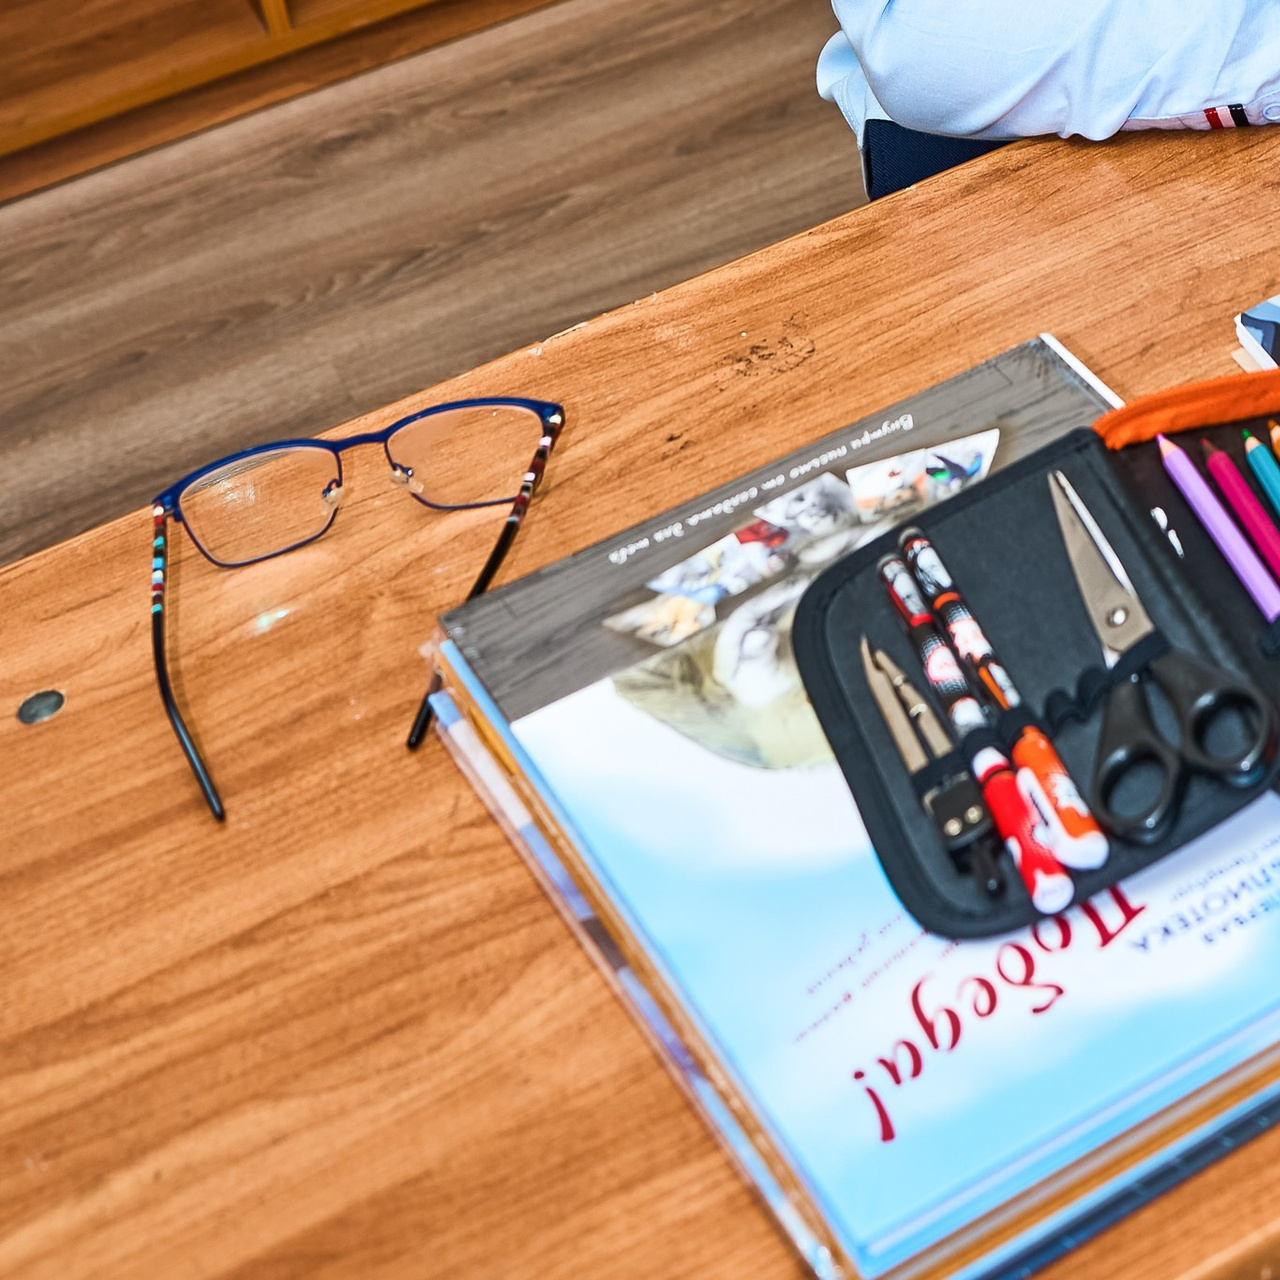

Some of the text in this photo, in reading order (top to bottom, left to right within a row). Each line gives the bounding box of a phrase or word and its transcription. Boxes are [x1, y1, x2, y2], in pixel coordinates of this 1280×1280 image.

[608, 413, 914, 565] Внутри письмо от солдата для тебя
